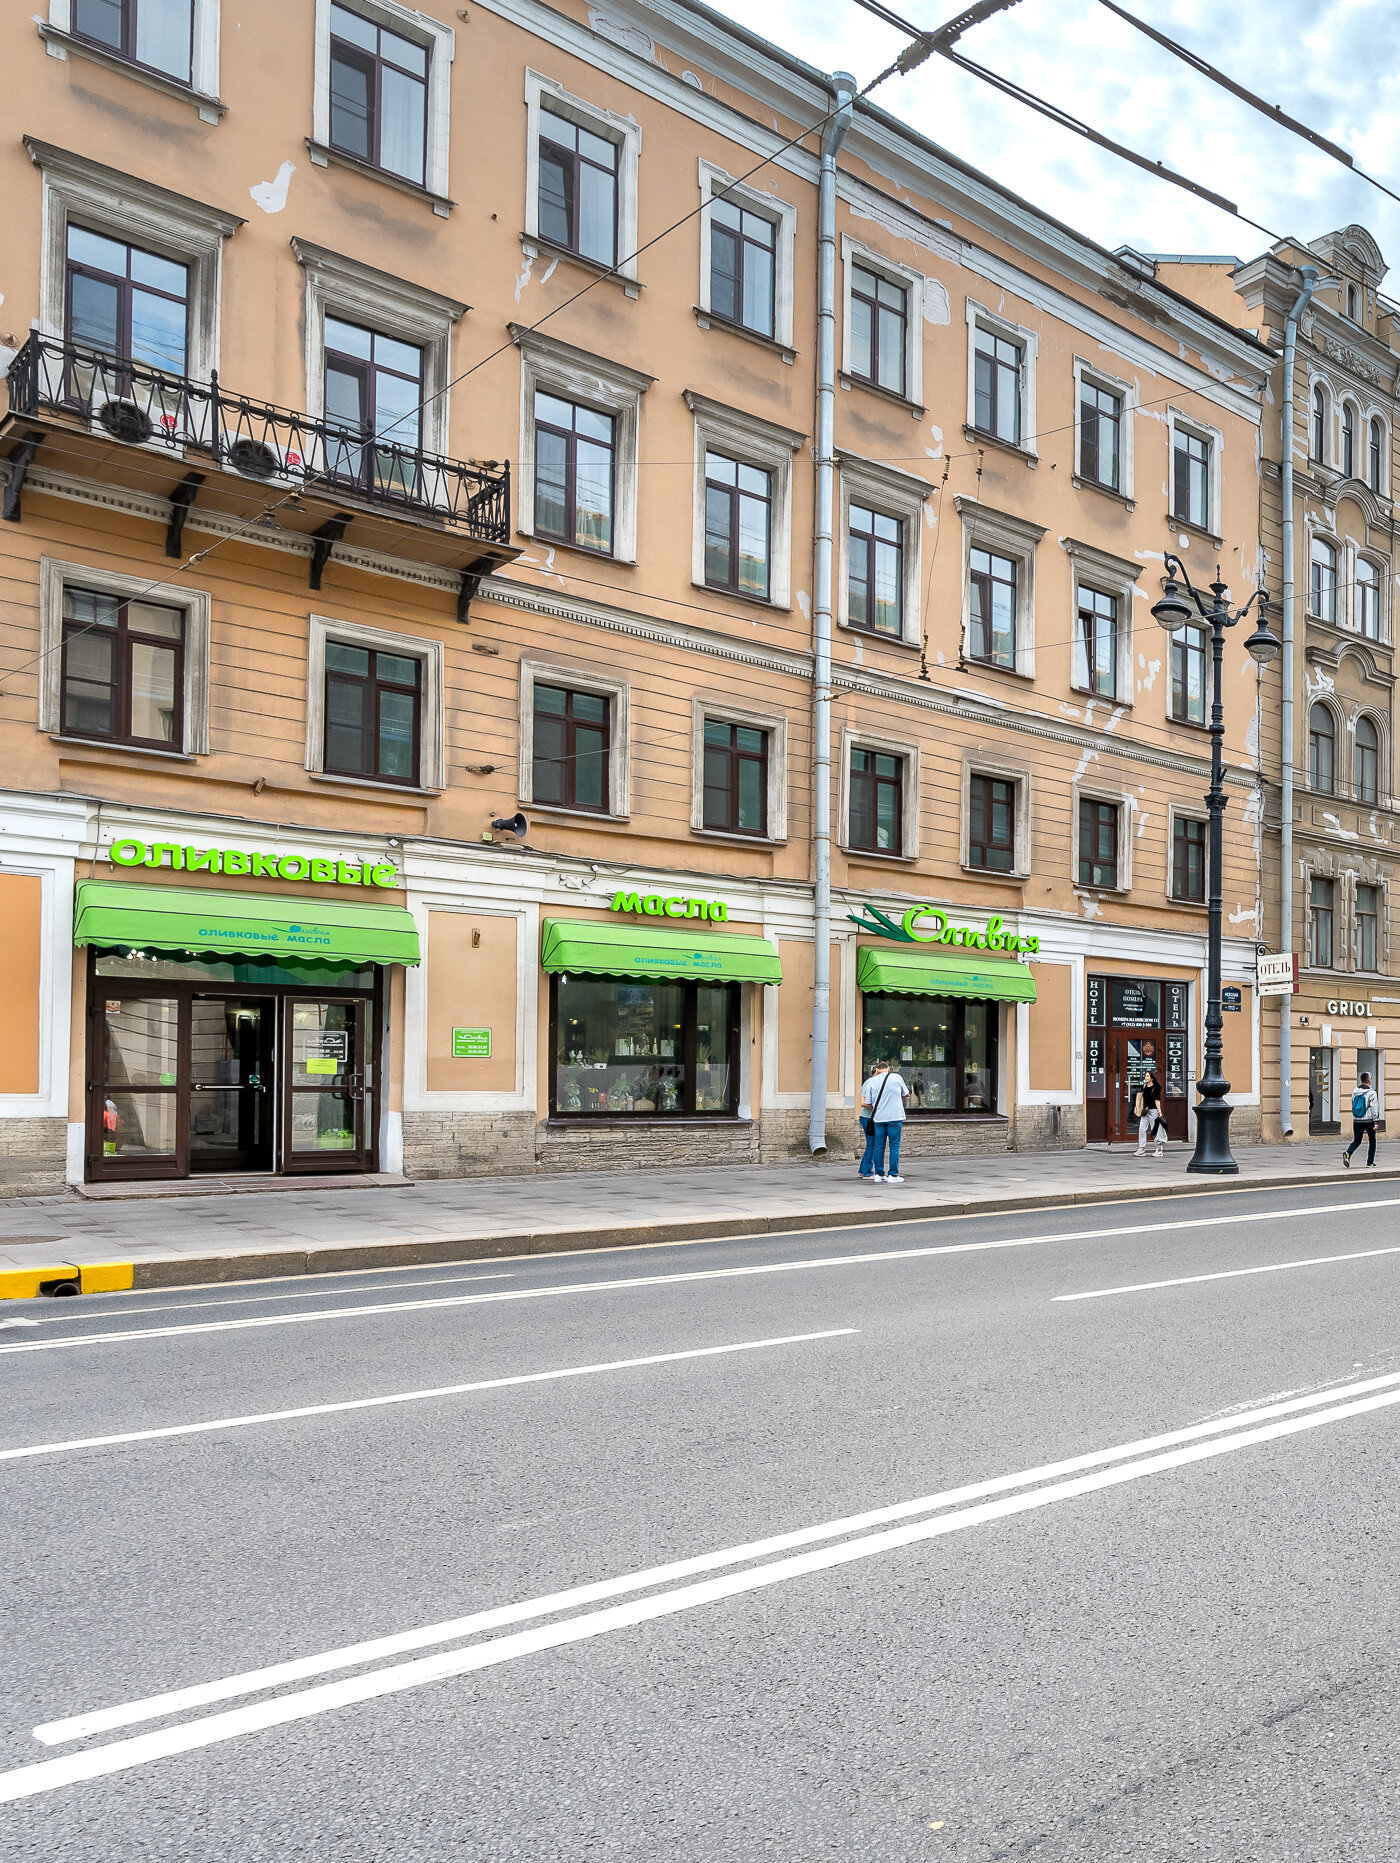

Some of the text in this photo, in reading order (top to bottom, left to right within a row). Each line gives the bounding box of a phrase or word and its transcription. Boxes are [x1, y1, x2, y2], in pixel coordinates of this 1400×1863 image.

[109, 838, 398, 888] оливковые
[611, 891, 728, 922] масла
[198, 928, 331, 945] оливковые масла
[901, 903, 1040, 954] Оливия
[634, 957, 688, 966] оливковые
[1260, 961, 1291, 975] ОТЕЛЬ
[1090, 981, 1099, 1024] HOTEL
[1171, 987, 1180, 1027] ОТЕЛЬ
[1327, 1000, 1373, 1017] GRIOL
[1090, 1040, 1099, 1083] HOTEL
[1168, 1041, 1182, 1080] HOTEL
